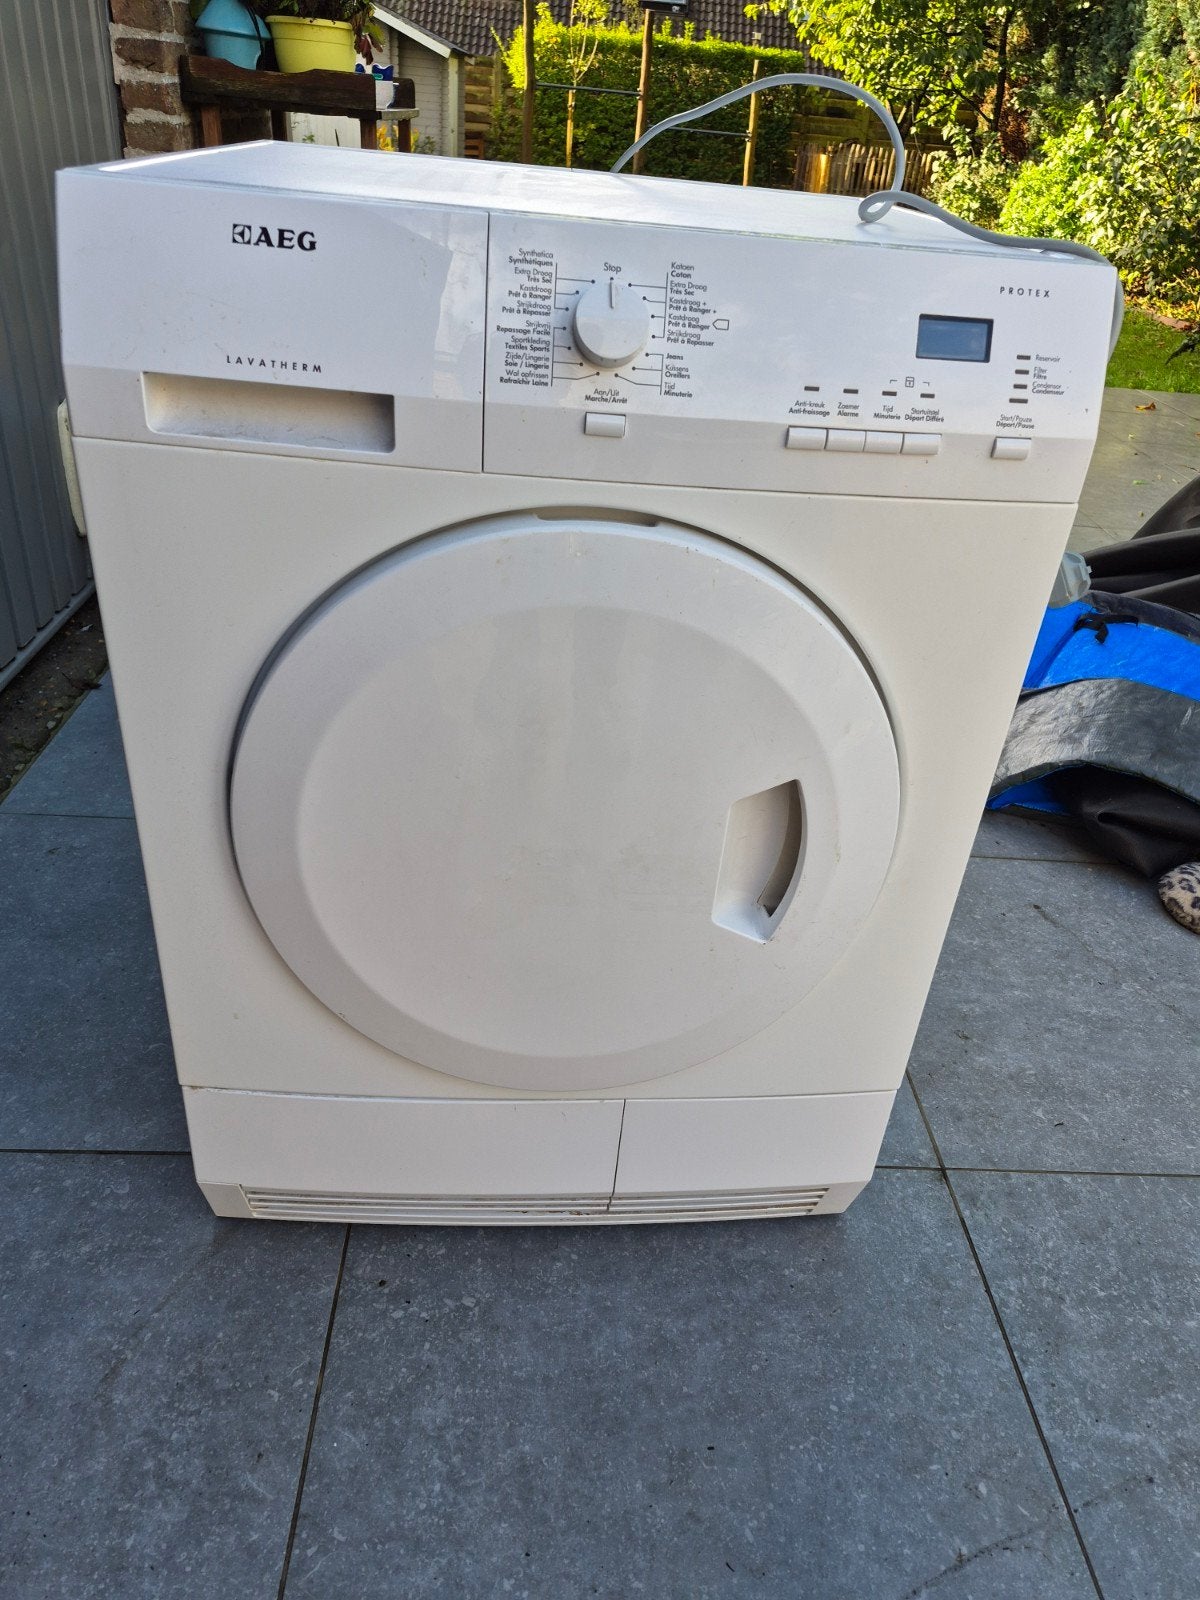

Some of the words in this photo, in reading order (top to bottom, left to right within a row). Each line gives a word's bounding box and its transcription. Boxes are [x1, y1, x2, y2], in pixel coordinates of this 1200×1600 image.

[253, 226, 317, 251] AEG
[514, 267, 531, 275] Extra
[532, 269, 553, 278] Droog
[604, 262, 622, 274] Stop
[671, 271, 692, 279] Coton
[520, 284, 553, 295] Kastdroog
[670, 281, 686, 289] Extra
[688, 282, 707, 292] Droog
[529, 292, 552, 301] Ranger
[1000, 286, 1050, 298] PROTEX
[517, 300, 551, 311] Strijkdroog
[669, 297, 701, 308] Kastdroog
[522, 309, 551, 318] Repasser
[690, 306, 711, 315] Ranger
[668, 313, 700, 324] Kastdroog
[497, 325, 531, 335] Repassage
[533, 328, 551, 336] Facile
[688, 323, 710, 331] Ranger
[667, 330, 701, 340] Strijkdroog
[511, 335, 551, 347] Sportkleding
[687, 339, 714, 347] Repasser
[505, 342, 528, 351] Textiles
[530, 344, 550, 353] Sports
[505, 352, 550, 363] Zijde/Lingerie
[666, 353, 684, 361] Jeans
[1035, 354, 1061, 363] Reservoir
[227, 355, 322, 373] LAVATHERM
[525, 361, 550, 371] Lingerie
[665, 372, 690, 380] Oreillers
[664, 382, 675, 391] Tijd
[1033, 382, 1062, 390] Condensor
[593, 388, 620, 397] Aan/Uit
[664, 390, 693, 398] Minuterie
[1032, 388, 1065, 396] Condenseur
[585, 395, 628, 403] Marche/Arrêt
[795, 400, 826, 409] Anti-kreuk
[883, 405, 894, 414] Tijd
